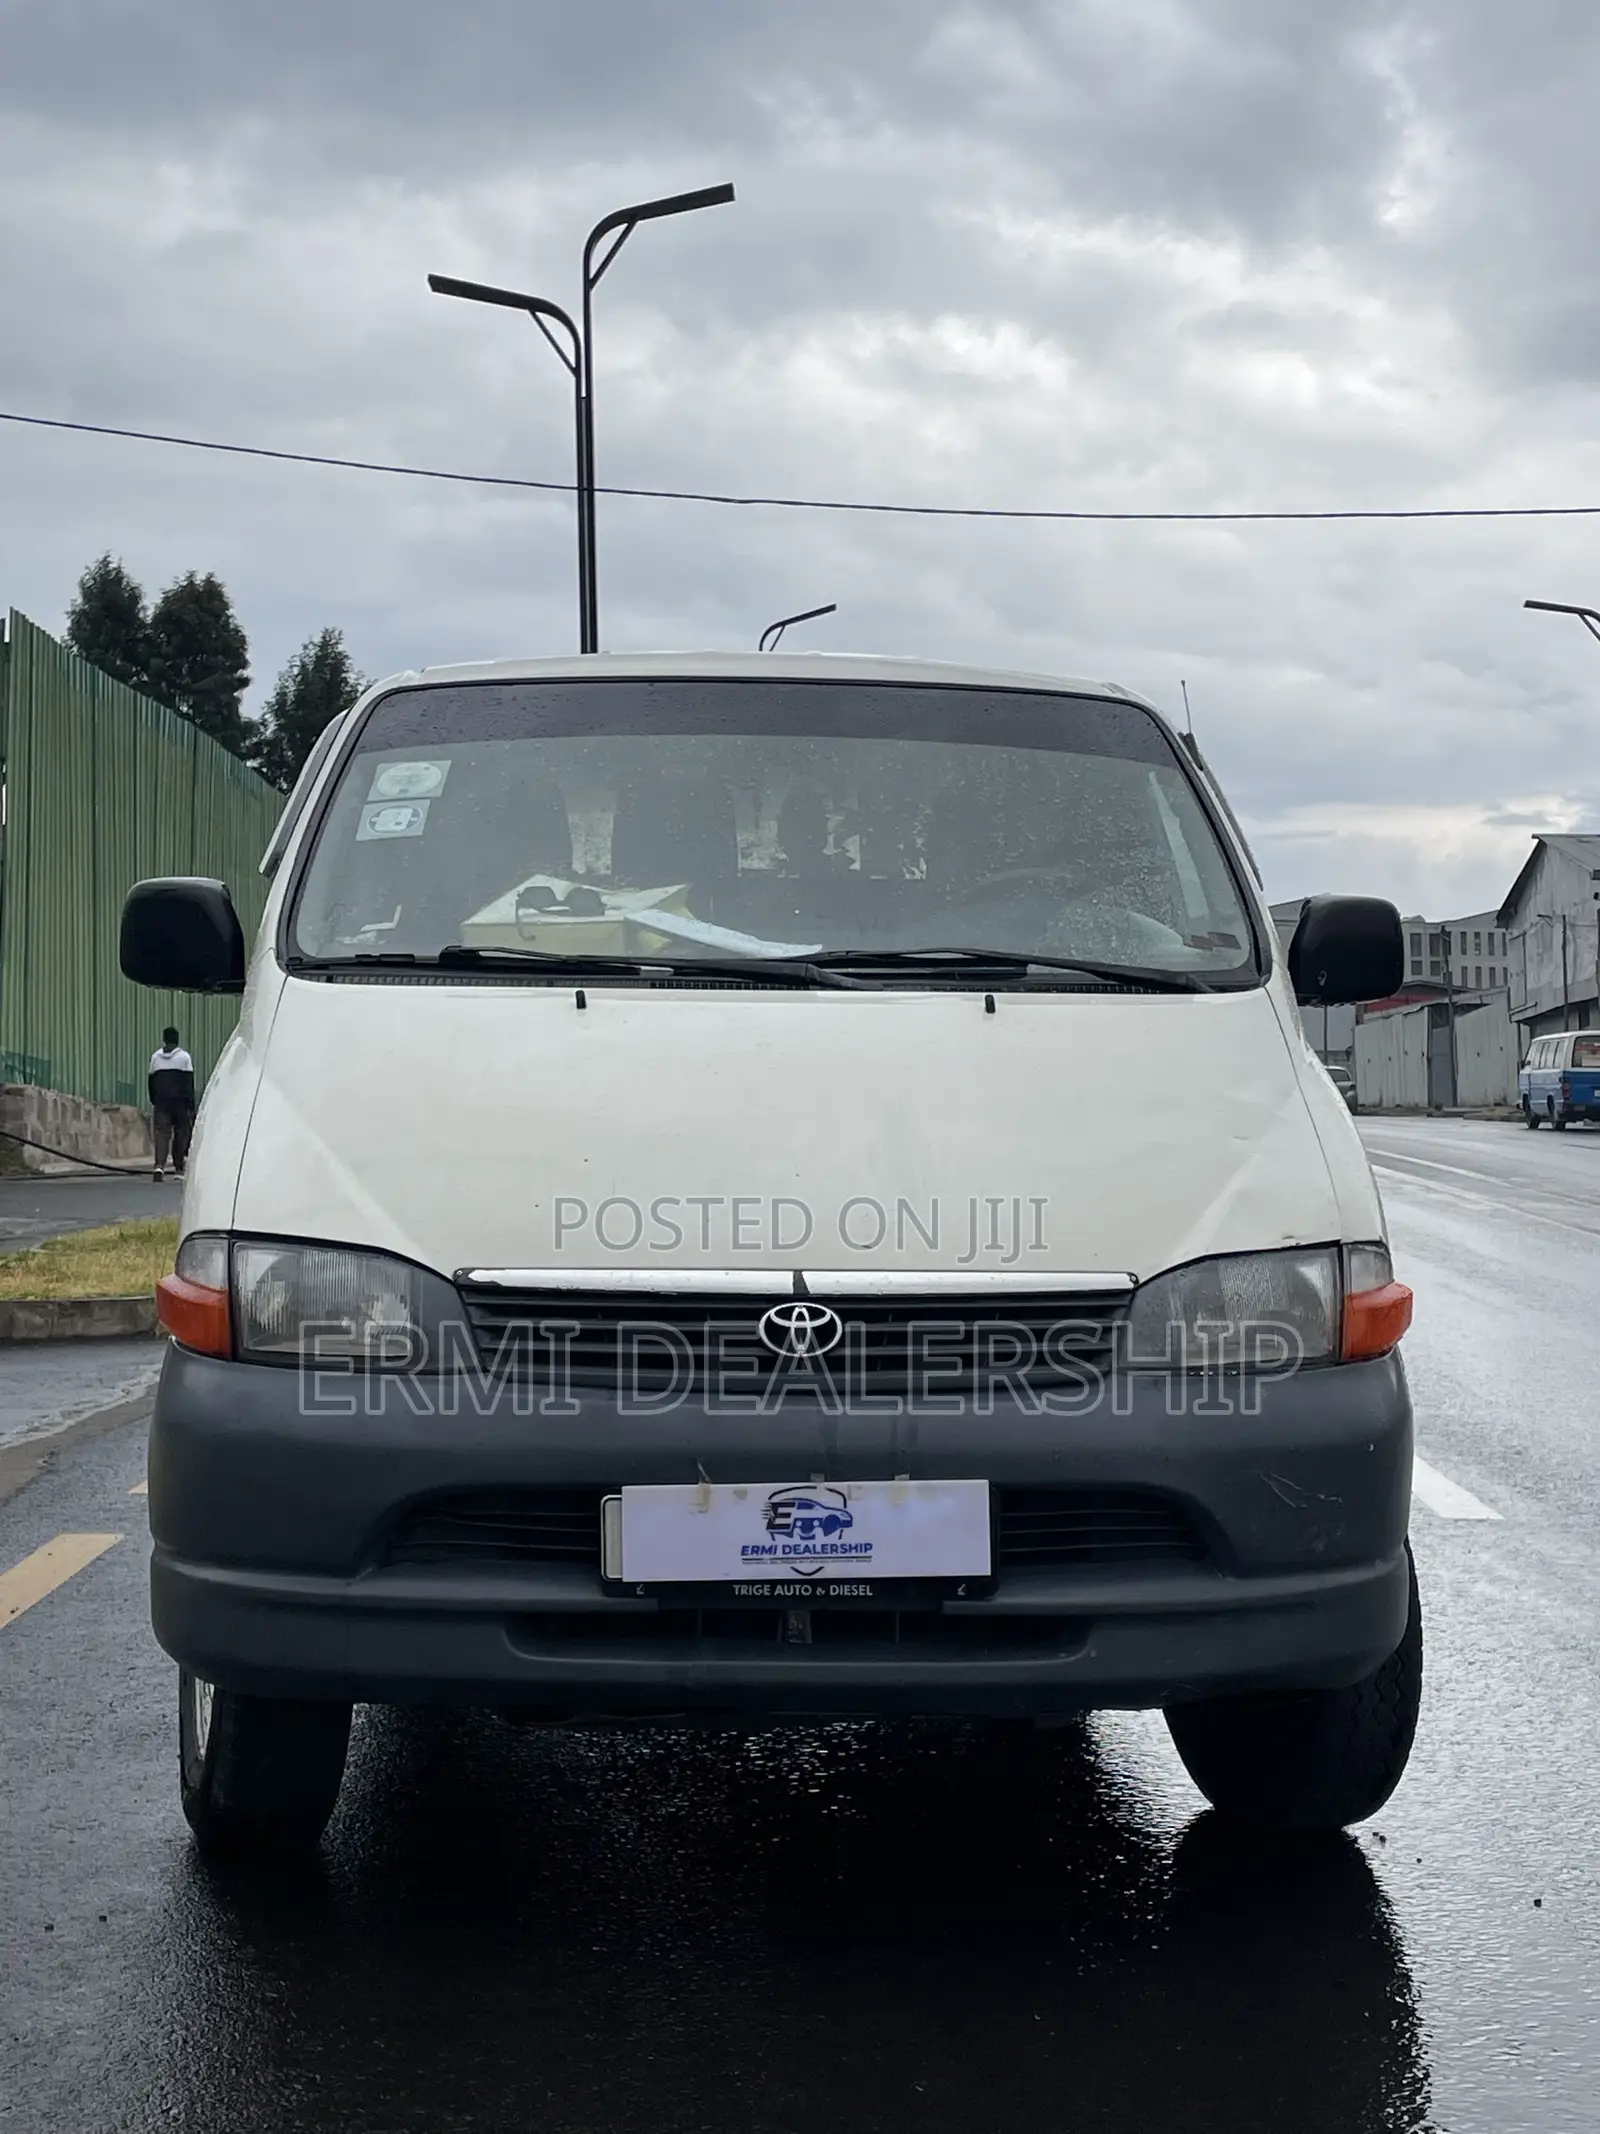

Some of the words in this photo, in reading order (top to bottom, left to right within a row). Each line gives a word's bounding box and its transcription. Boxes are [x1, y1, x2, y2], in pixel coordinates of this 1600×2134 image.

[740, 1544, 778, 1557] ERMI
[781, 1542, 874, 1556] DEALERSHIP
[732, 1584, 772, 1597] TRIGE
[773, 1584, 813, 1597] AUTO
[815, 1586, 826, 1597] &
[829, 1584, 874, 1597] DIESEL
